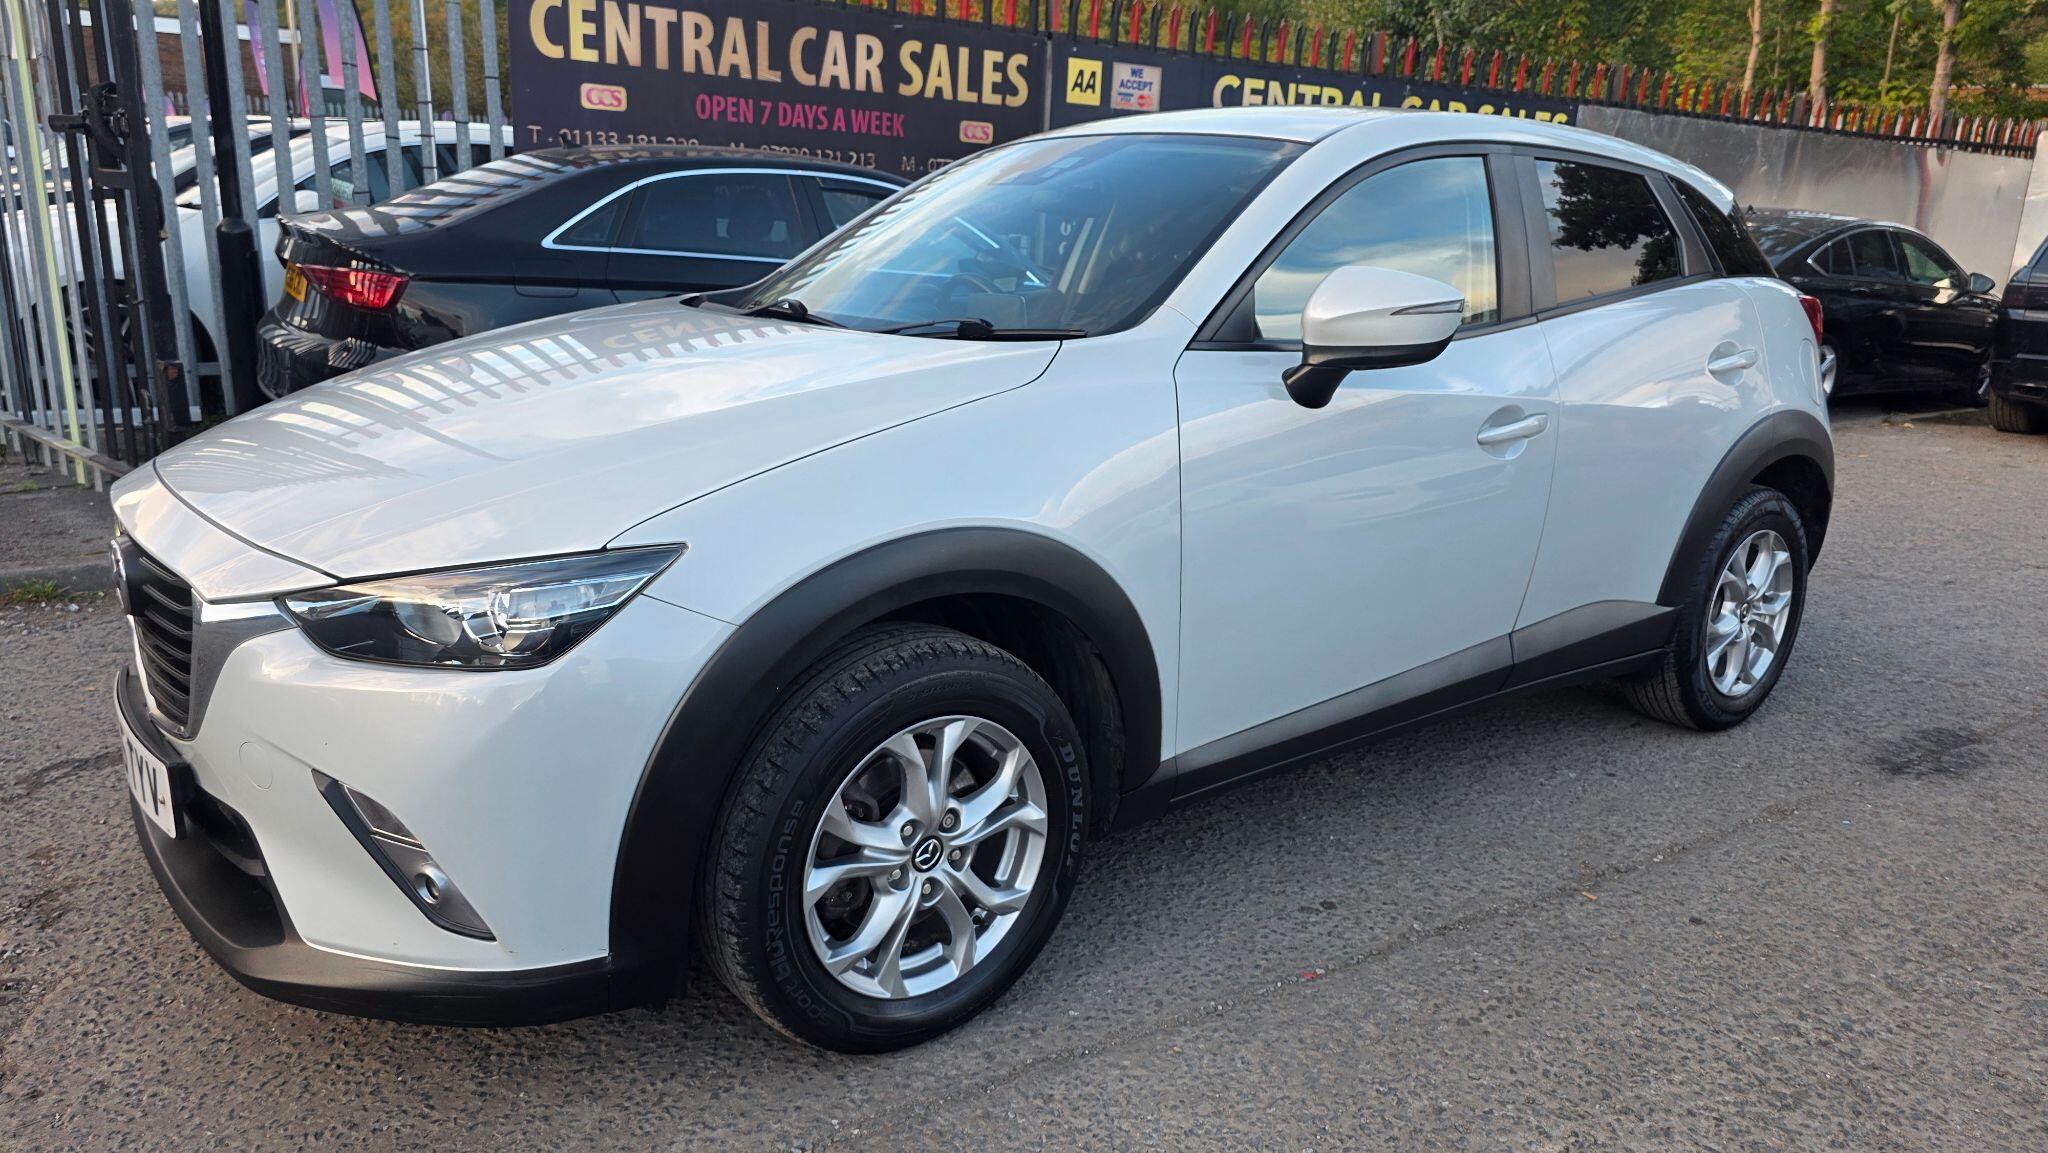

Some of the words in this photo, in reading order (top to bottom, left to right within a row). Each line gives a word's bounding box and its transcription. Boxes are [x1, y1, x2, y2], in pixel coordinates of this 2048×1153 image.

[529, 0, 782, 82] CENTRAL
[789, 27, 884, 93] CAR
[898, 40, 1029, 107] SALES
[1071, 69, 1096, 94] AA
[1130, 68, 1144, 78] WE
[1119, 79, 1153, 92] ACCEPT
[586, 87, 622, 107] CCS
[696, 94, 754, 124] OPEN
[760, 101, 772, 125] 7
[778, 102, 828, 130] DAYS
[832, 107, 846, 132] A
[850, 108, 904, 137] WEEK
[963, 124, 990, 141] CCS
